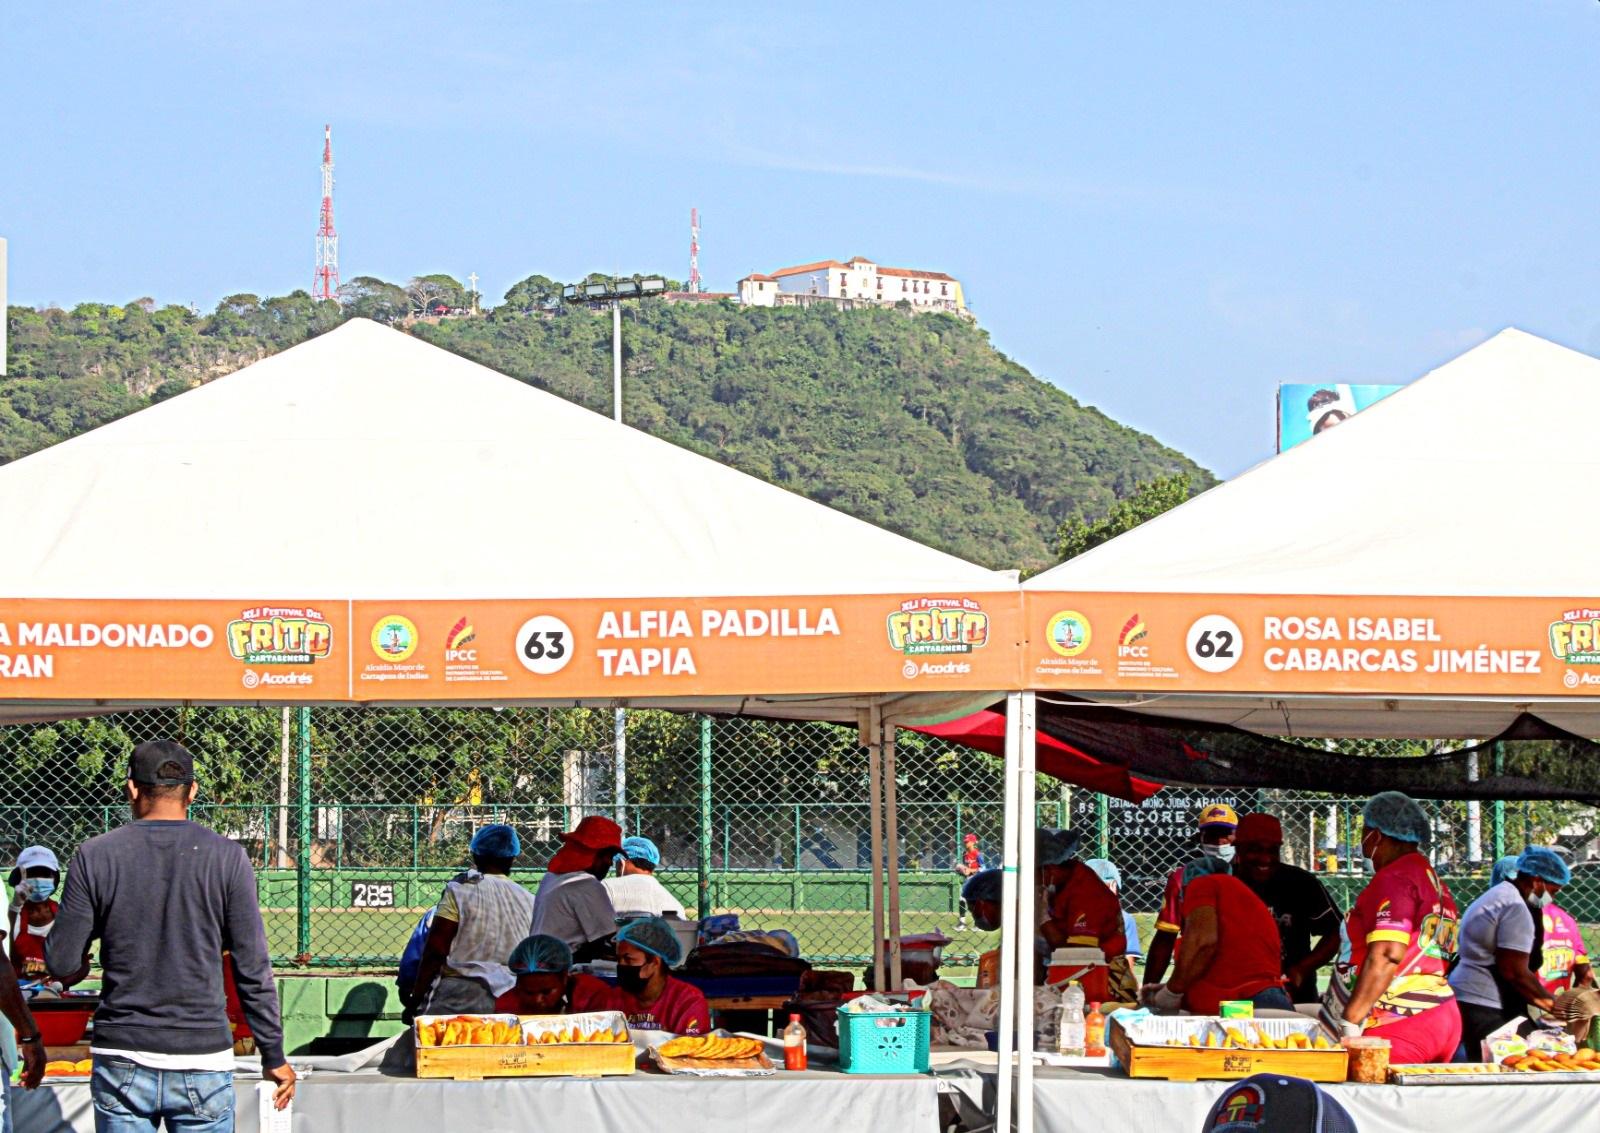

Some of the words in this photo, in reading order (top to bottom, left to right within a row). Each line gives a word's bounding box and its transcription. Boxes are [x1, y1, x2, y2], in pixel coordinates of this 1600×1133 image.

[18, 623, 214, 648] MALDONADO
[597, 610, 693, 639] ALFIA
[702, 607, 840, 637] PADILLA
[889, 609, 988, 648] FRITO
[1264, 616, 1341, 640] ROSA
[1348, 617, 1441, 642] ISABEL
[229, 618, 331, 657] FRITO
[524, 631, 565, 659] 63
[1195, 630, 1234, 658] 62
[446, 650, 477, 661] IPCC
[597, 647, 696, 676] TAPIA
[1118, 646, 1148, 657] IPCC
[1264, 647, 1417, 672] CABARCAS
[1425, 645, 1541, 674] JIMÉNEZ
[260, 671, 313, 685] Acodrés
[920, 661, 970, 675] Acodrés
[1124, 810, 1185, 824] SCORE
[354, 883, 393, 907] 285
